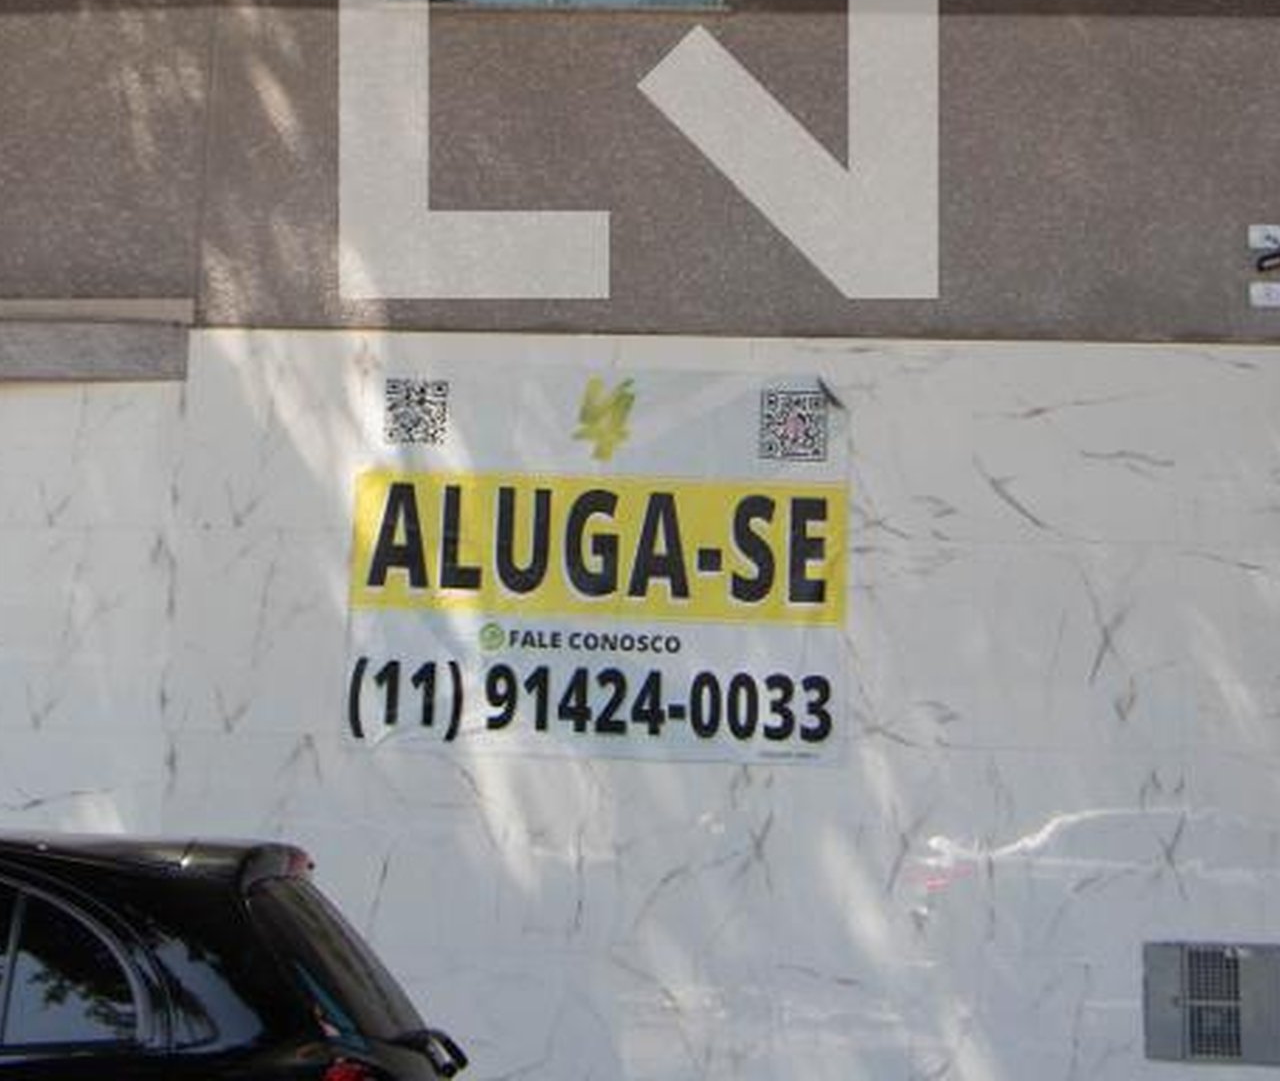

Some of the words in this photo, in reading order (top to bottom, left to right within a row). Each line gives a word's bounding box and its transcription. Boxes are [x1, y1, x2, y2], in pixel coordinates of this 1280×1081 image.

[366, 481, 828, 604] ALUGA-SE
[508, 629, 562, 649] FALE
[568, 631, 682, 654] CONOSCO
[348, 656, 464, 743] (11)
[484, 663, 833, 743] 91424-0033
